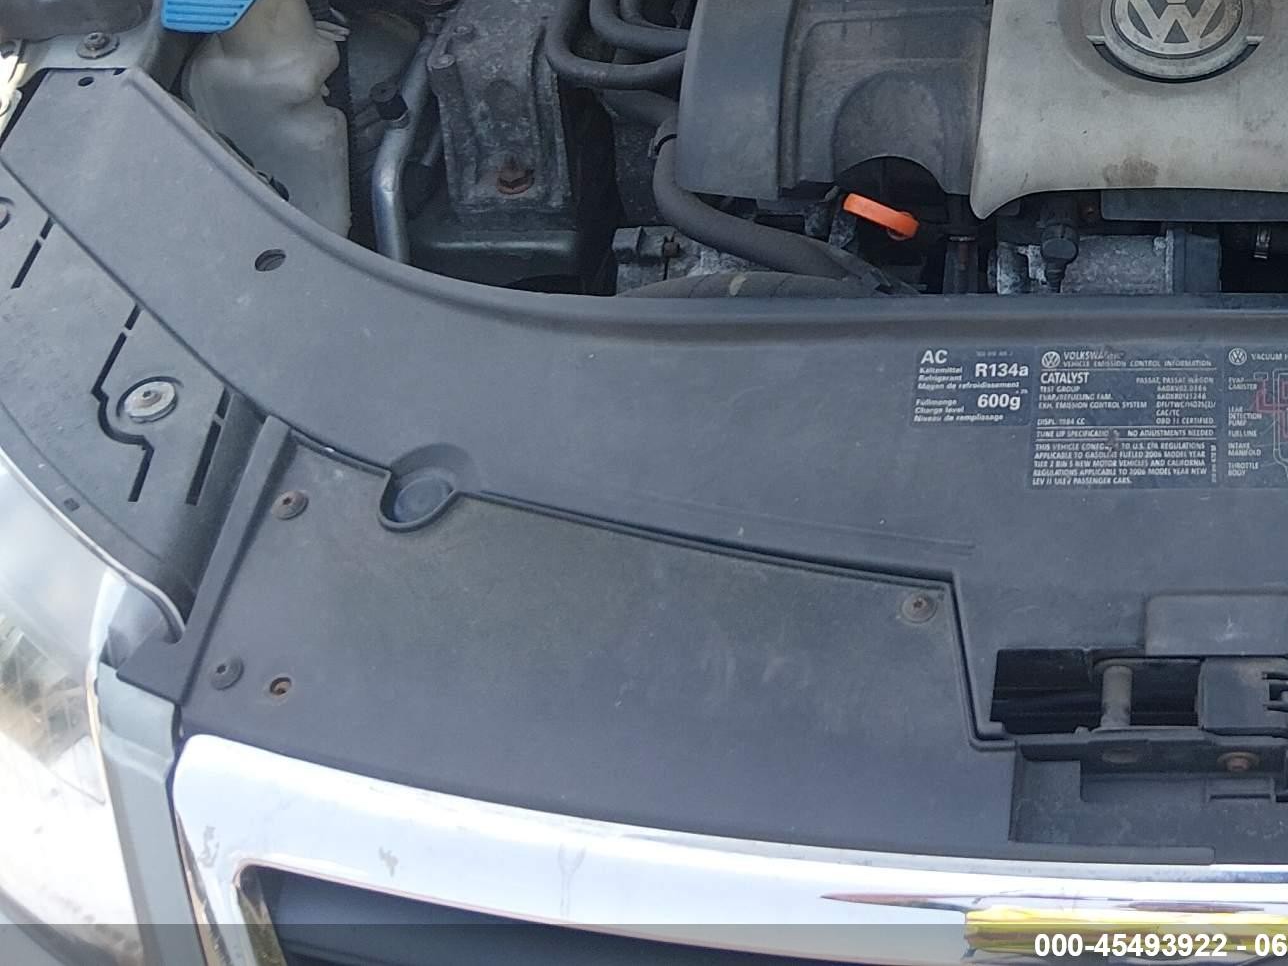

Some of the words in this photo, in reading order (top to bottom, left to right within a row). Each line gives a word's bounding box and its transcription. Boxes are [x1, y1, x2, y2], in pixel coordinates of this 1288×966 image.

[921, 349, 948, 364] AC
[1251, 353, 1282, 361] VACUUM
[975, 363, 1029, 377] R134a
[1041, 372, 1090, 384] CATALYST
[1040, 385, 1054, 393] TEST
[1056, 385, 1080, 393] GROUP
[977, 393, 1021, 411] 600g
[1056, 401, 1088, 410] EMISSION
[1089, 401, 1120, 410] CONTROL
[1122, 401, 1147, 410] SYSTEM
[915, 406, 943, 415] Charge
[945, 406, 965, 415] level
[1156, 417, 1171, 425] OBD
[1181, 417, 1214, 425] CERTIFIED
[1037, 430, 1054, 438] TUNE
[1128, 429, 1138, 437] NO
[1139, 429, 1186, 437] ADJUSTMENTS
[1188, 429, 1214, 437] NEEDED
[1035, 443, 1050, 451] THIS
[1052, 443, 1079, 451] VEHICLE
[1160, 442, 1205, 450] REGULATIONS
[1034, 451, 1073, 459] APPLICABLE
[1119, 451, 1144, 459] FUELED
[1164, 451, 1187, 459] MODEL
[1189, 451, 1206, 459] YEAR
[1228, 462, 1259, 470] THROTTLE
[1033, 468, 1078, 476] REGULATIONS
[1079, 468, 1117, 476] APPLICABLE
[1148, 468, 1171, 476] MODEL
[1172, 468, 1189, 476] YEAR
[1191, 468, 1207, 476] NEW
[1032, 477, 1045, 485] LEV
[1073, 477, 1111, 485] PASSENGER
